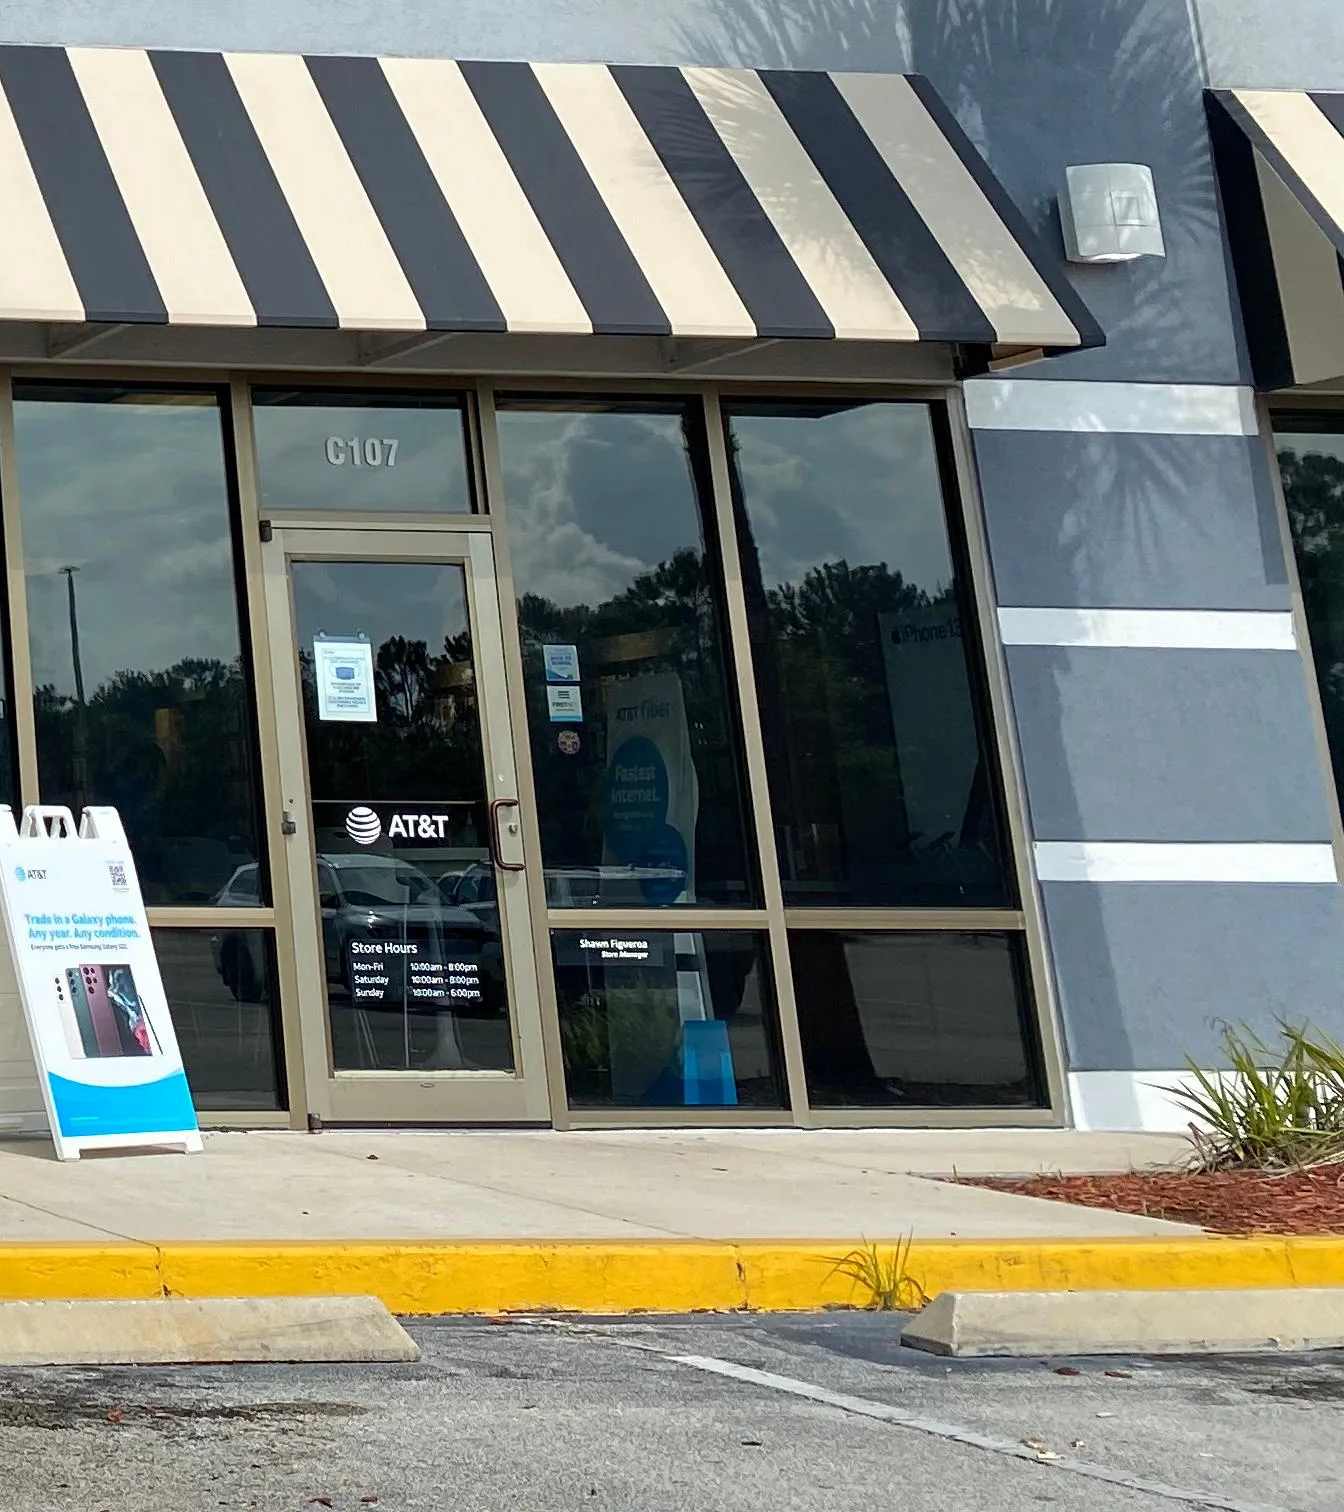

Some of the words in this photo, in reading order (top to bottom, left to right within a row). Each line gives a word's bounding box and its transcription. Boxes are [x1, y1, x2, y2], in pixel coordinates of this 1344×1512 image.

[325, 436, 398, 466] C107
[900, 623, 947, 644] iPhone
[615, 763, 656, 783] Fastest
[388, 814, 449, 838] AT&T
[27, 869, 47, 880] AT&T
[24, 913, 52, 925] Trade
[54, 914, 63, 925] in
[65, 916, 71, 925] a
[72, 913, 104, 928] Galaxy
[106, 913, 137, 926] phone.
[29, 928, 47, 941] Any
[74, 927, 92, 941] Any
[94, 926, 140, 939] condition.
[352, 942, 383, 954] Store
[384, 942, 418, 954] Hours
[579, 938, 610, 949] Shawn
[610, 938, 648, 950] Figueroa
[601, 950, 619, 958] Store
[619, 950, 649, 960] Manager
[353, 962, 384, 971] Mon-Fri
[354, 975, 389, 985] Saturday
[355, 988, 384, 999] Sunday
